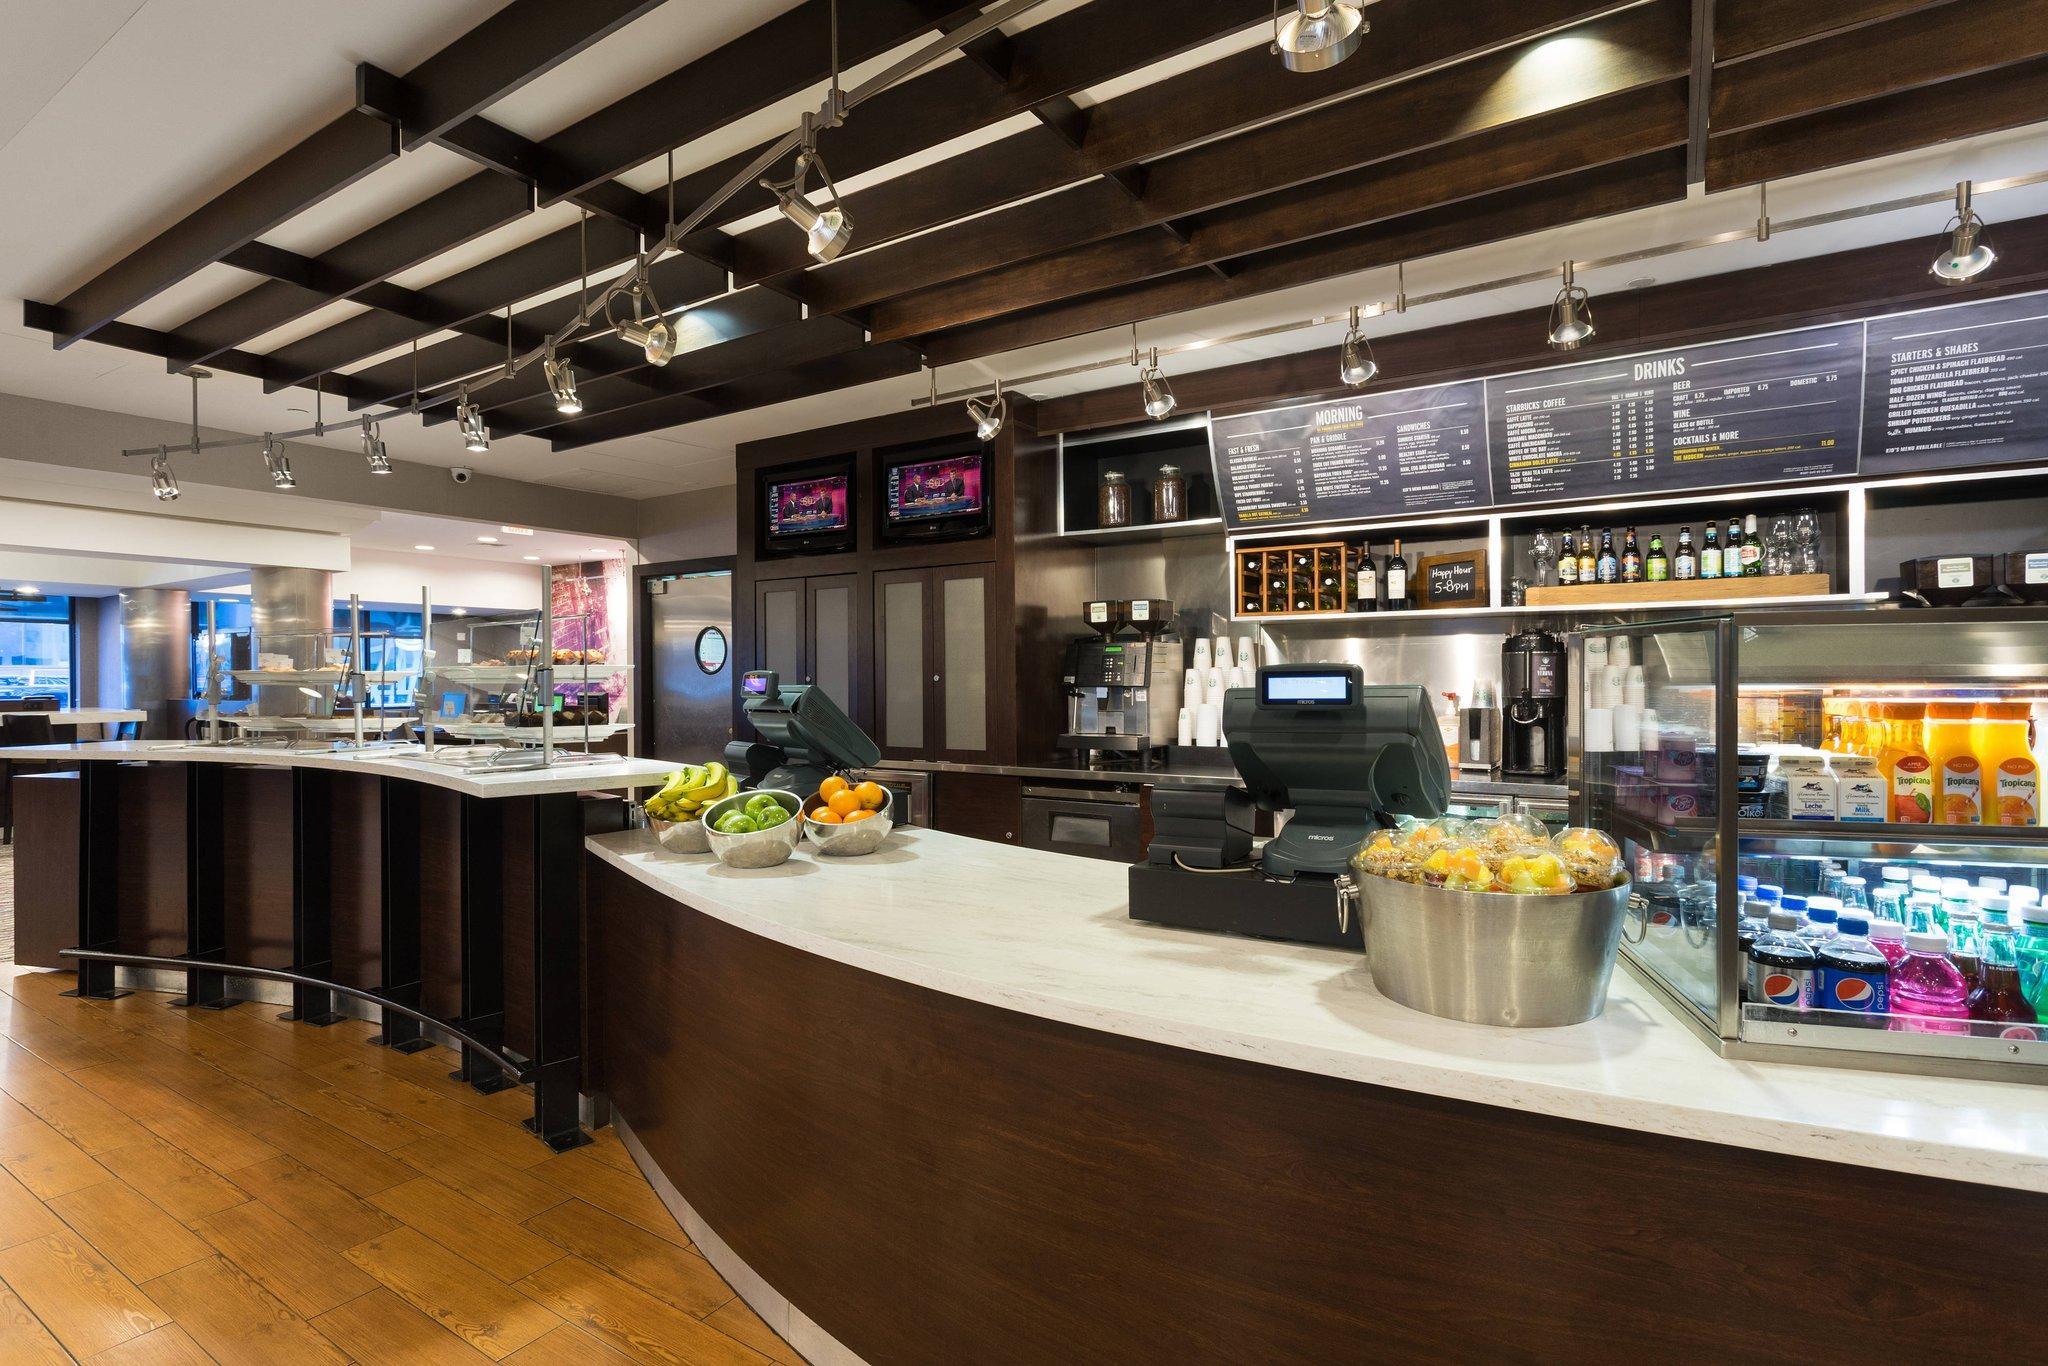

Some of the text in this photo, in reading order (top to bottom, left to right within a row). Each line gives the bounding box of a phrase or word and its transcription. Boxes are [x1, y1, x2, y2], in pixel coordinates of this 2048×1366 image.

[1892, 343, 1979, 363] STARTERS & SHARES
[1635, 357, 1685, 381] DRINKS
[1891, 368, 1908, 376] SPICY
[1909, 364, 1935, 373] CHICKEN
[1942, 360, 1969, 369] SPINACH
[1970, 355, 2006, 365] FLATBREAD
[1790, 377, 1818, 387] DOMESTIC
[1890, 377, 1914, 385] TOMATO
[1915, 371, 1954, 382] MOZZARELLA
[1955, 367, 1989, 377] FLATBREAD
[1673, 380, 1691, 391] BEER
[1903, 384, 1929, 393] CHICKEN
[1930, 380, 1964, 389] FLATBREAD
[1927, 391, 1947, 399] WINGS
[1506, 398, 1566, 414] STARBUCKS COFFEE
[1888, 410, 1912, 418] GRILLED
[1913, 407, 1939, 416] CHICKEN
[1940, 403, 1976, 413] QUESADILLA
[1316, 405, 1363, 426] MORNING
[1673, 409, 1691, 419] WINE
[1673, 421, 1689, 429] GLASS
[1888, 419, 1911, 427] SHRIMP
[1912, 415, 1951, 425] POTSTICKERS
[1397, 422, 1431, 433] SANDWICHES
[1905, 426, 1932, 434] HUMMUS
[1326, 433, 1347, 442] GRIDDLE
[1674, 431, 1740, 446] COCKTAILS & MORE
[1228, 447, 1239, 455] FAST
[1432, 566, 1474, 580] Happy Hour
[1897, 777, 1930, 786] Tropicana
[1947, 777, 1979, 787] Tropicana
[2000, 779, 2036, 788] Tropicana
[1805, 978, 1815, 1007] pepsi
[1876, 982, 1884, 1010] pepsi
